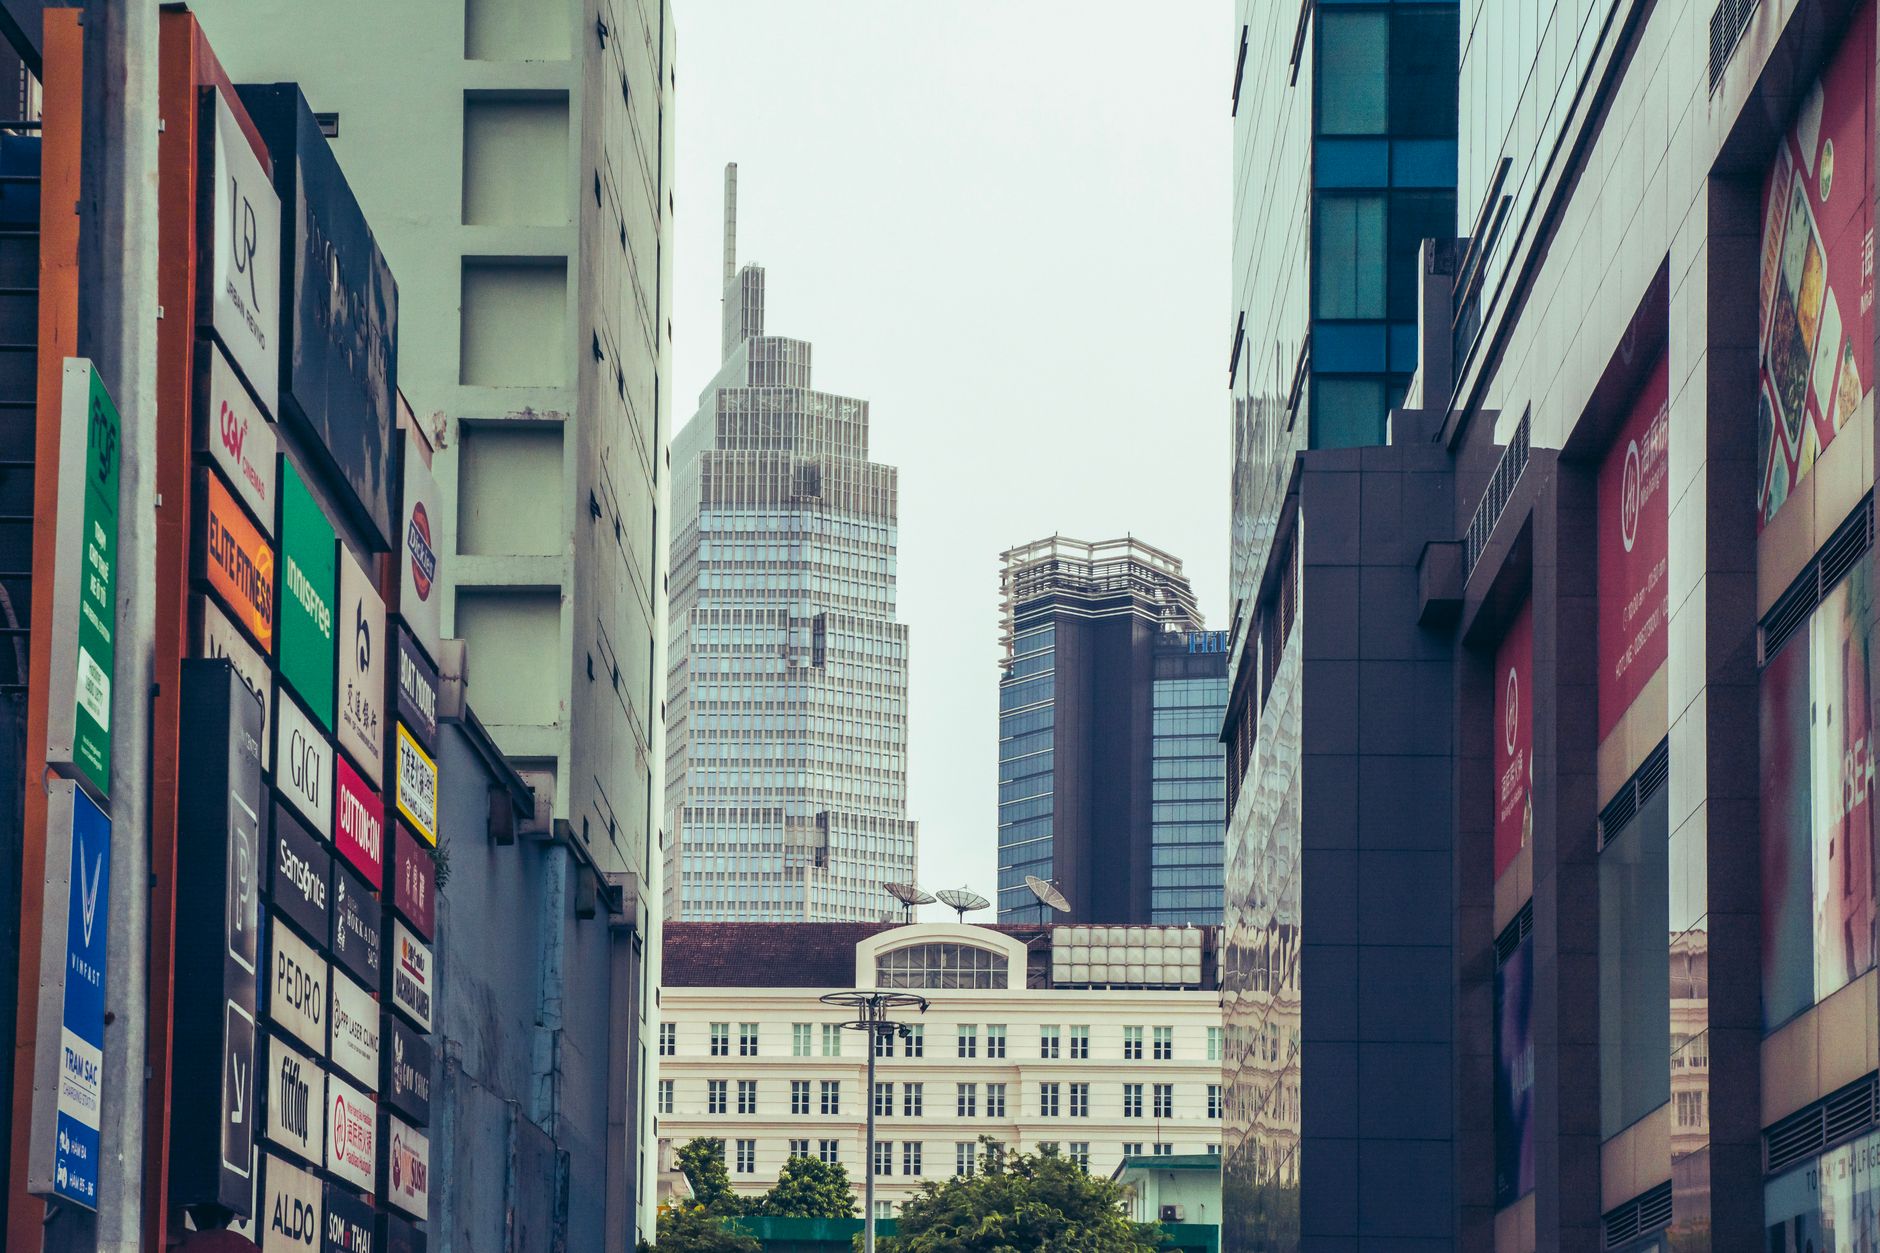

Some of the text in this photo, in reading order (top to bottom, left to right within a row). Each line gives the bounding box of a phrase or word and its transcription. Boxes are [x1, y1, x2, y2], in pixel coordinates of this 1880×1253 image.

[1861, 227, 1874, 288] 海
[226, 275, 266, 351] URBAN REVIVO
[221, 400, 245, 465] CGV
[242, 455, 265, 501] CINEMAS
[209, 510, 235, 582] ELITE
[235, 543, 271, 626] FITNESS
[400, 646, 415, 699] BOAT
[415, 668, 437, 728] NOODLE
[291, 728, 320, 809] GIGI
[280, 838, 325, 911] Samsonite
[346, 907, 379, 951] HOKKAIDO
[71, 952, 101, 988] VINFAST
[278, 950, 321, 1026] PEDRO
[349, 1015, 363, 1042] LASER
[363, 1027, 379, 1053] CLINIC
[65, 1047, 98, 1089] TRẠM SẠC
[281, 1055, 309, 1148] fitflop
[410, 1156, 427, 1195] SUSHI
[272, 1191, 315, 1246] ALDO
[328, 1211, 345, 1247] SOM
